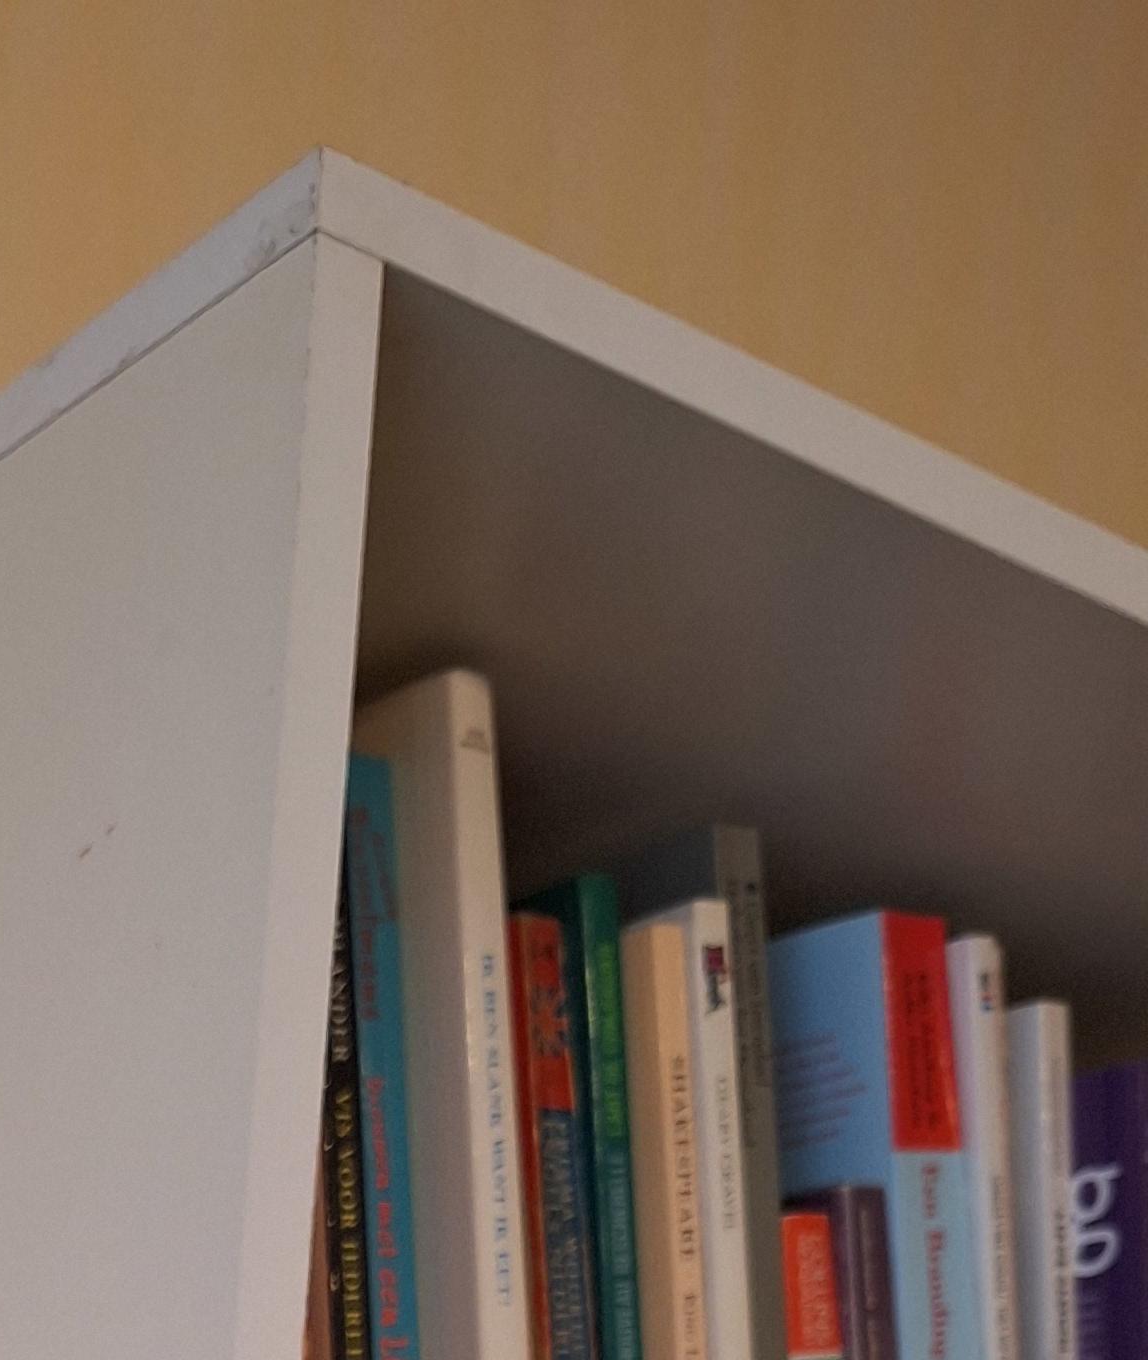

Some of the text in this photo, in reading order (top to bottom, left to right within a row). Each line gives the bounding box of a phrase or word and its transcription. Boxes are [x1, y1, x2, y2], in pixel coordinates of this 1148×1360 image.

[335, 1087, 353, 1138] VIS
[338, 1148, 358, 1230] VOOR
[376, 1201, 398, 1259] met
[378, 1267, 399, 1328] een
